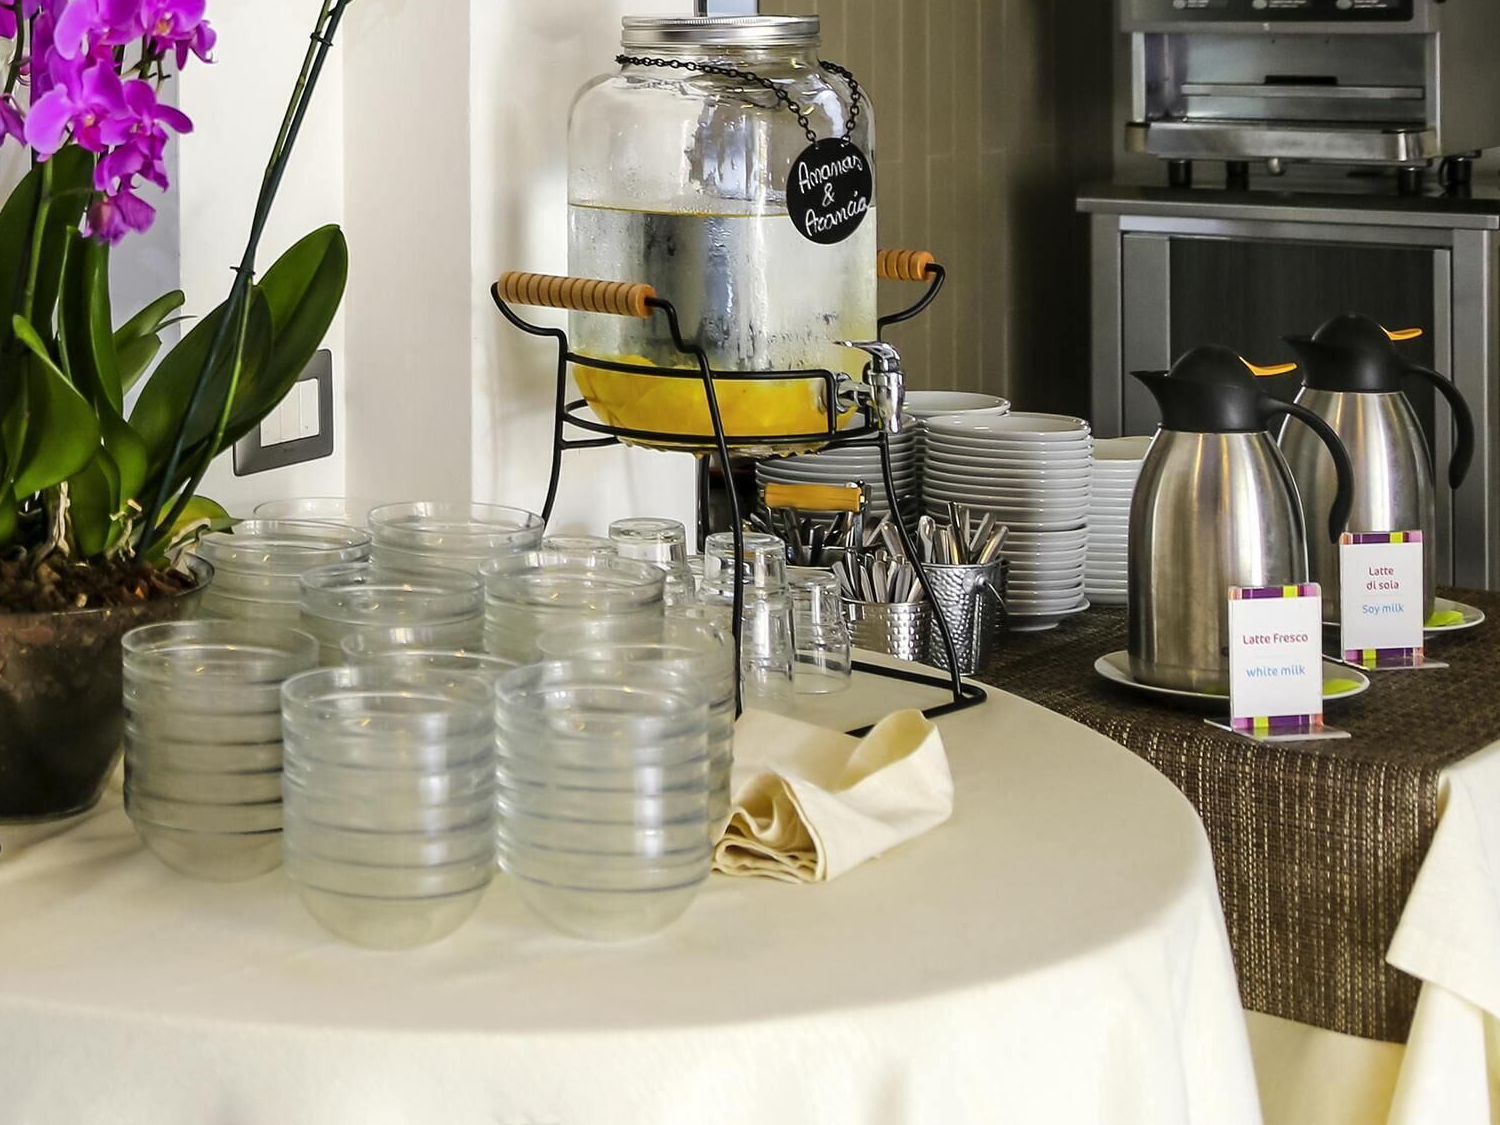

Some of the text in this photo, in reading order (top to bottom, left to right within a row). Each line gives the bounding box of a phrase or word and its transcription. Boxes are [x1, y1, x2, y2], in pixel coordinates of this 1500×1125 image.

[822, 182, 835, 207] &
[1368, 567, 1394, 577] Latte
[1366, 580, 1399, 590] di soia
[1362, 603, 1404, 615] Soy milk
[1242, 633, 1309, 645] Latte Fresco
[1246, 664, 1306, 677] white milk
